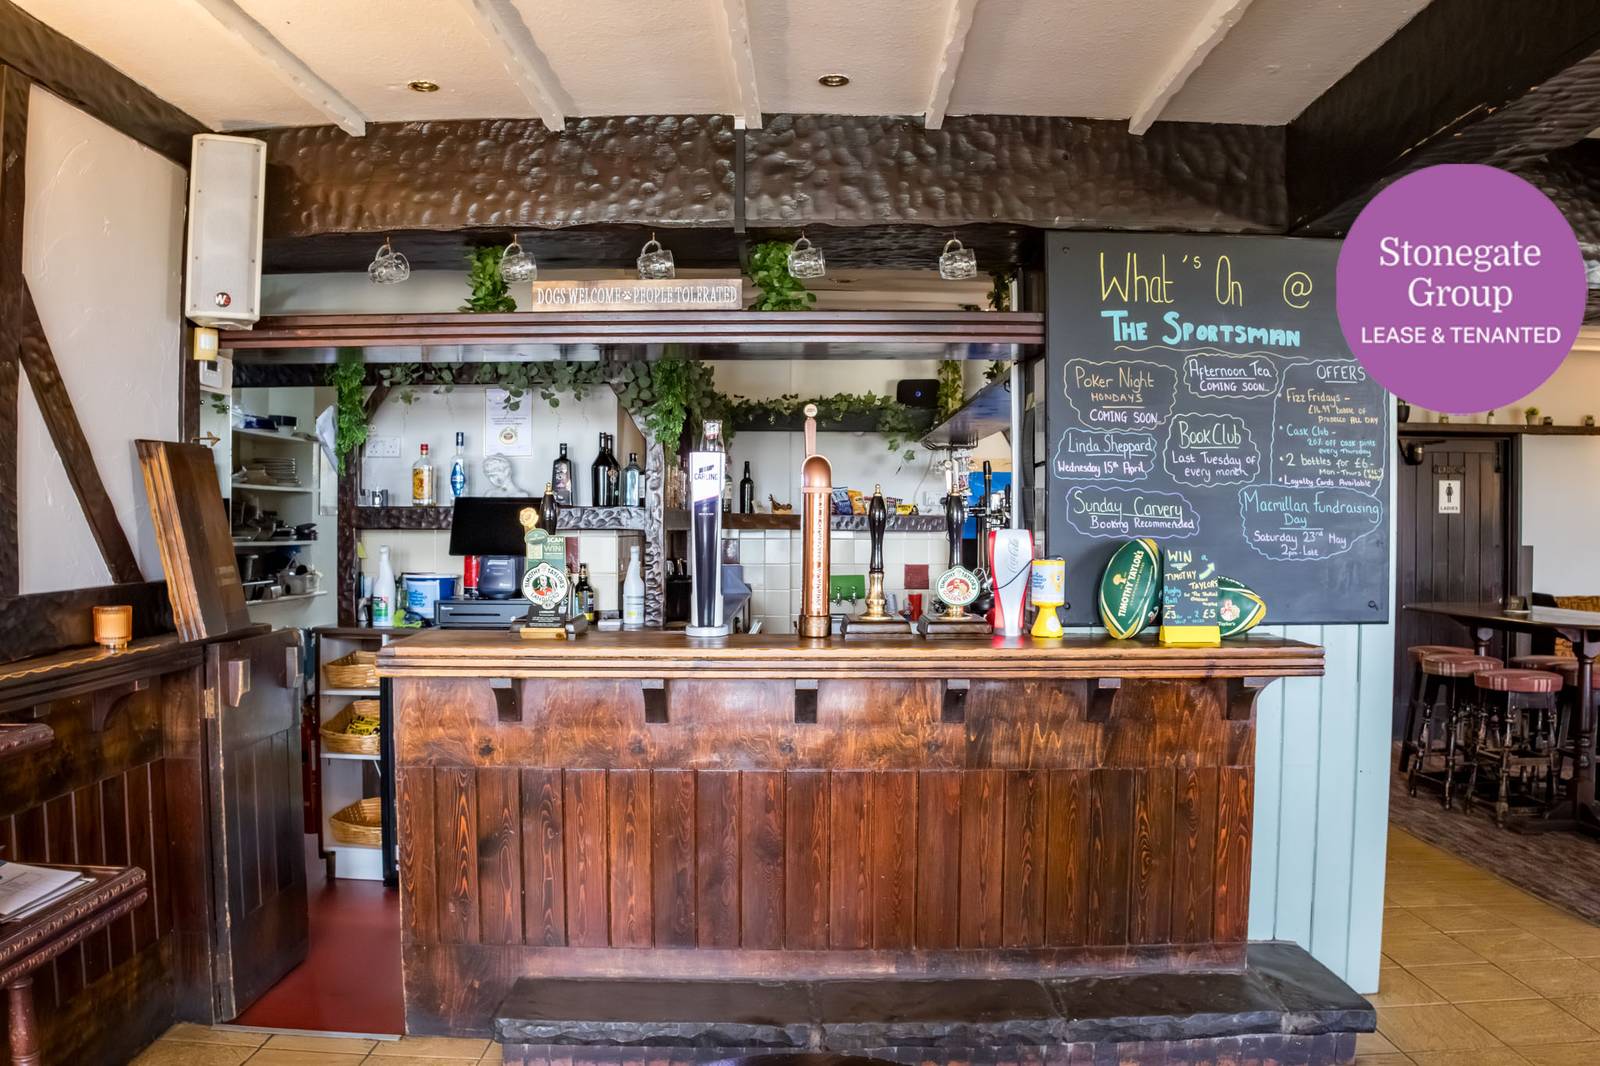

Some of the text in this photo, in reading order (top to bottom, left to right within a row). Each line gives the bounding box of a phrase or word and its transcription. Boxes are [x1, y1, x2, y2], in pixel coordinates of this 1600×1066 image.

[1216, 255, 1243, 307] On
[1283, 271, 1313, 309] @
[536, 286, 738, 305] DOGS WELCOME PEOPLE TOLERATED
[1101, 310, 1301, 347] THE SPORTSMAN
[1189, 358, 1272, 380] Afternoon Tea
[1316, 365, 1366, 381] OFFERS
[1075, 366, 1155, 393] Poker Night
[1200, 380, 1265, 392] COMING SOON
[1091, 392, 1143, 402] MONDAYS
[1286, 387, 1306, 403] Fizz
[1307, 388, 1341, 408] Fridays
[1090, 409, 1158, 424] COMING SOON
[1364, 416, 1379, 425] DAY
[1178, 420, 1242, 449] Book Club
[1286, 424, 1309, 437] Cask
[1311, 425, 1329, 437] Club
[1068, 432, 1154, 460] Linda Sheppard
[1171, 450, 1257, 469] Last Tuesday of
[1286, 453, 1296, 467] 2
[1300, 453, 1332, 466] bottles
[1335, 458, 1350, 469] for
[1354, 457, 1368, 468] £6
[1057, 460, 1101, 478] Wednesday
[1122, 460, 1145, 476] April
[1184, 466, 1249, 483] every month
[1284, 475, 1314, 489] Loyalty
[1315, 477, 1334, 487] Cards
[1073, 490, 1183, 519] Sunday Carvery
[1244, 490, 1310, 513] Macmillan
[1090, 515, 1195, 533] Booking Recommended
[1284, 513, 1308, 529] Day
[1253, 530, 1347, 550] Saturday 23rd May
[1167, 549, 1192, 563] WIN
[1281, 544, 1298, 558] 2pm
[1303, 545, 1319, 556] Late
[1118, 581, 1134, 617] TIMOTHY
[1127, 550, 1145, 581] TAYLOR'S
[1165, 570, 1197, 581] TIMOTHY
[1188, 579, 1218, 590] TAYLORS
[1202, 608, 1217, 619] £5
